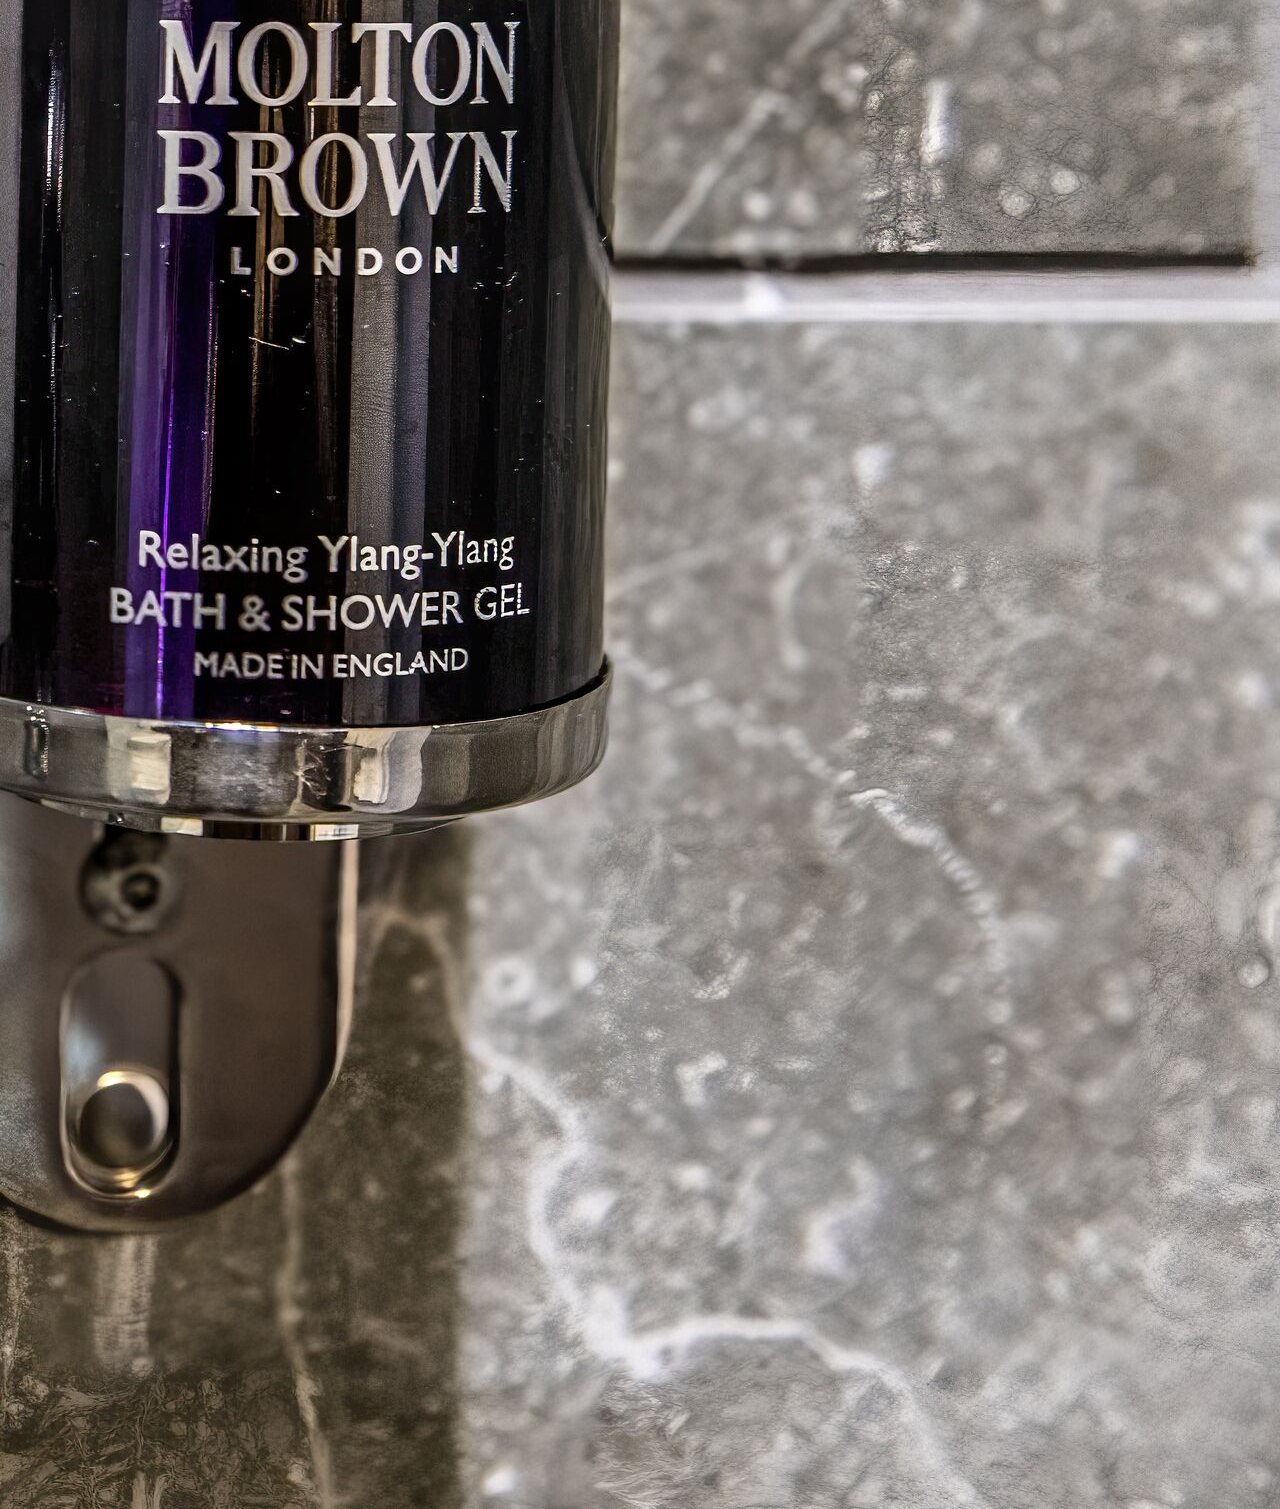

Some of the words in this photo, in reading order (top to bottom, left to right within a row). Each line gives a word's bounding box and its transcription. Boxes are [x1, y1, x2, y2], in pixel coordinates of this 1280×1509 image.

[157, 19, 521, 107] MOLTON
[156, 129, 519, 218] BROWN
[230, 245, 460, 277] LONDON
[138, 529, 308, 584] Relaxing
[317, 530, 516, 581] Ylang-Ylang
[109, 586, 226, 631] BATH
[238, 595, 271, 633] &
[280, 591, 465, 632] SHOWER
[473, 581, 531, 622] GEL
[192, 650, 284, 680] MADE
[290, 652, 326, 680] IN
[331, 647, 470, 679] ENGLAND
